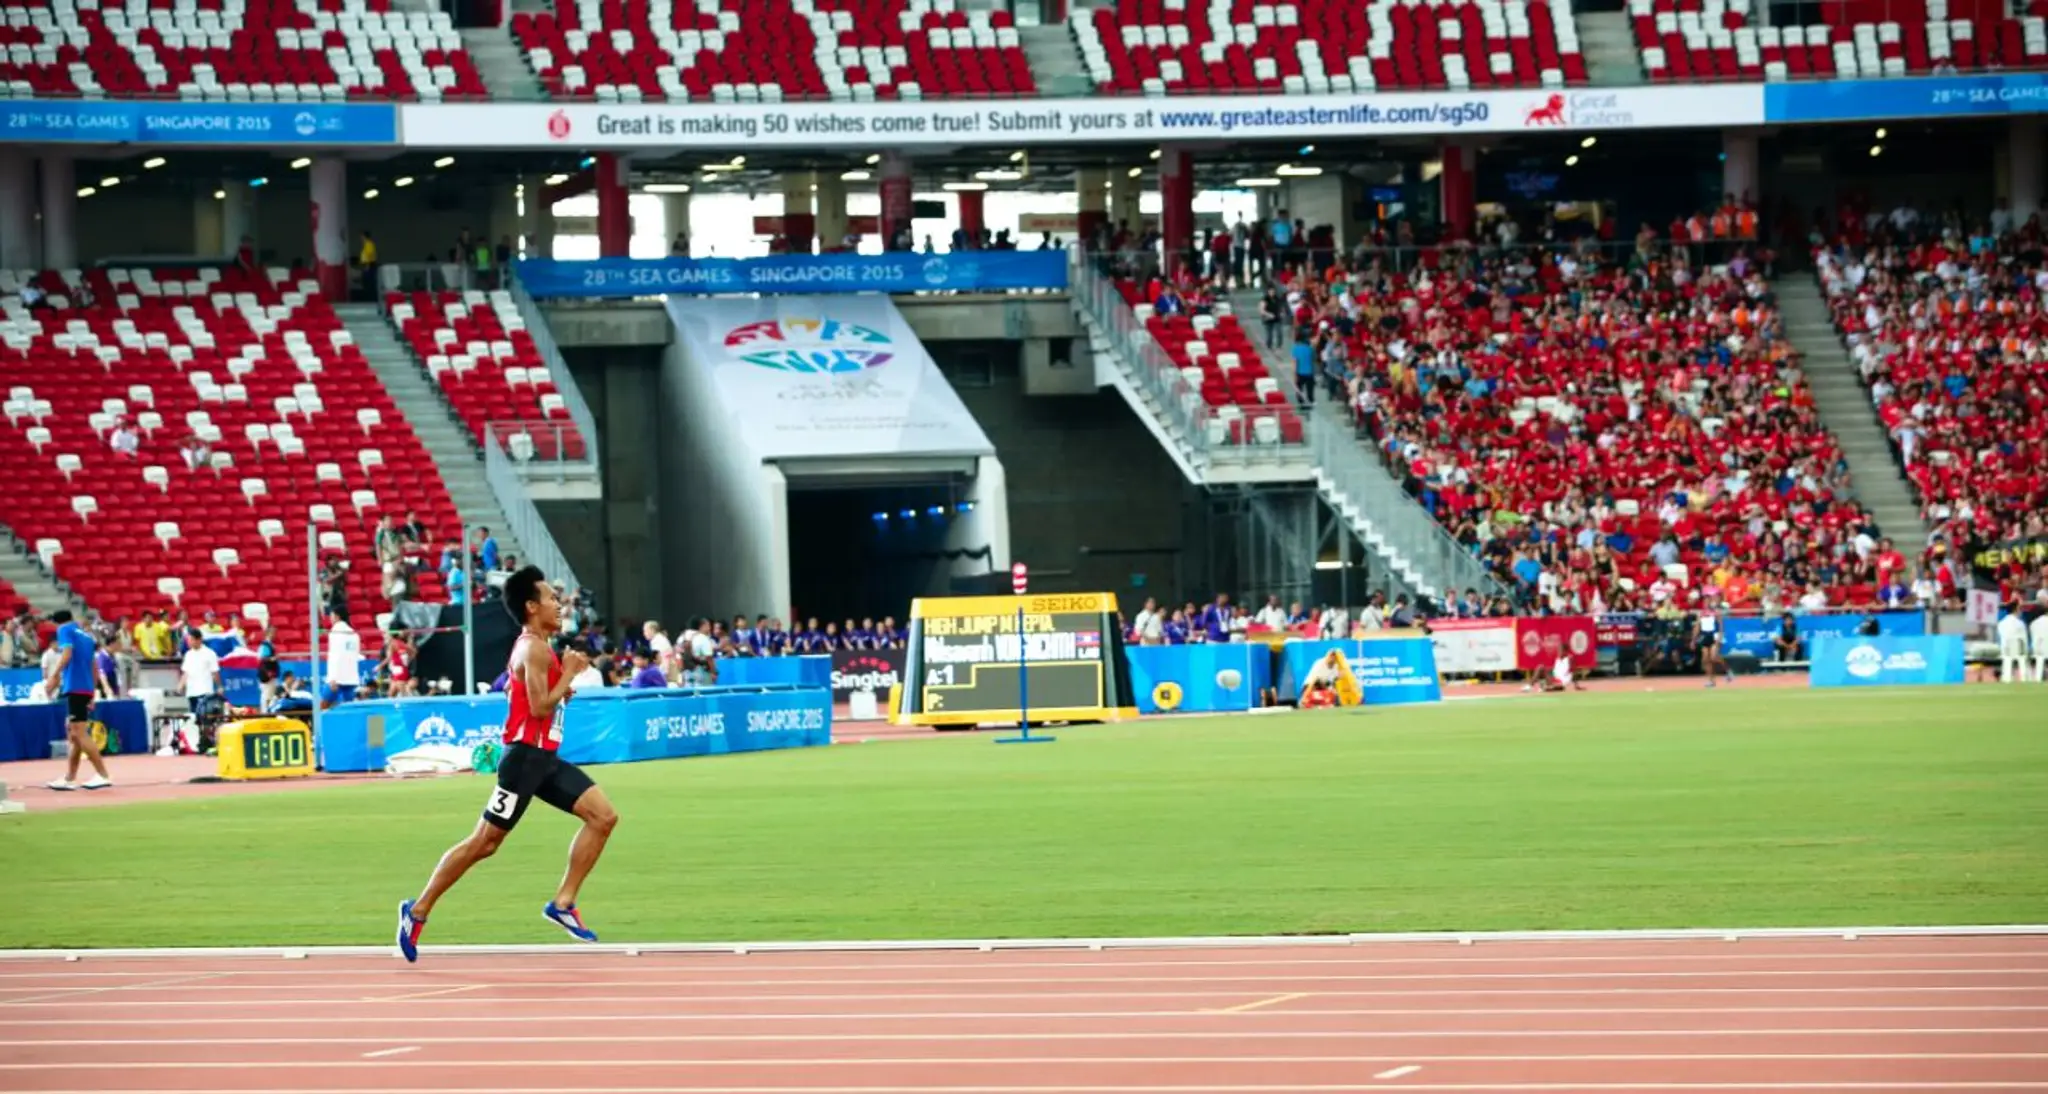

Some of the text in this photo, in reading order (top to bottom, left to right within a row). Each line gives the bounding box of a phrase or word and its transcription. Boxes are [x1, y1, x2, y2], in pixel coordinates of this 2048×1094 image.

[1969, 88, 1997, 102] SEA
[46, 114, 75, 128] SEA
[77, 114, 130, 129] GAMES
[145, 115, 232, 130] SINGAPORE
[236, 116, 272, 131] 2015
[597, 102, 1489, 138] Great is making 50 wishes come true! Submit yours at www.greateasternlife.com/sg50
[628, 268, 664, 286] SEA
[666, 267, 732, 285] GAMES
[750, 266, 856, 283] SINGAPORE
[861, 264, 905, 281] 2015
[1032, 596, 1098, 612] SEIKO
[924, 616, 957, 635] HIGH
[958, 615, 998, 634] JUMP
[830, 669, 898, 692] Singtel
[668, 715, 688, 738] SEA
[689, 713, 725, 737] GAMES
[747, 709, 801, 733] SINGAPORE
[803, 708, 824, 730] 2015
[254, 733, 304, 768] 1:00
[492, 791, 509, 814] 3
